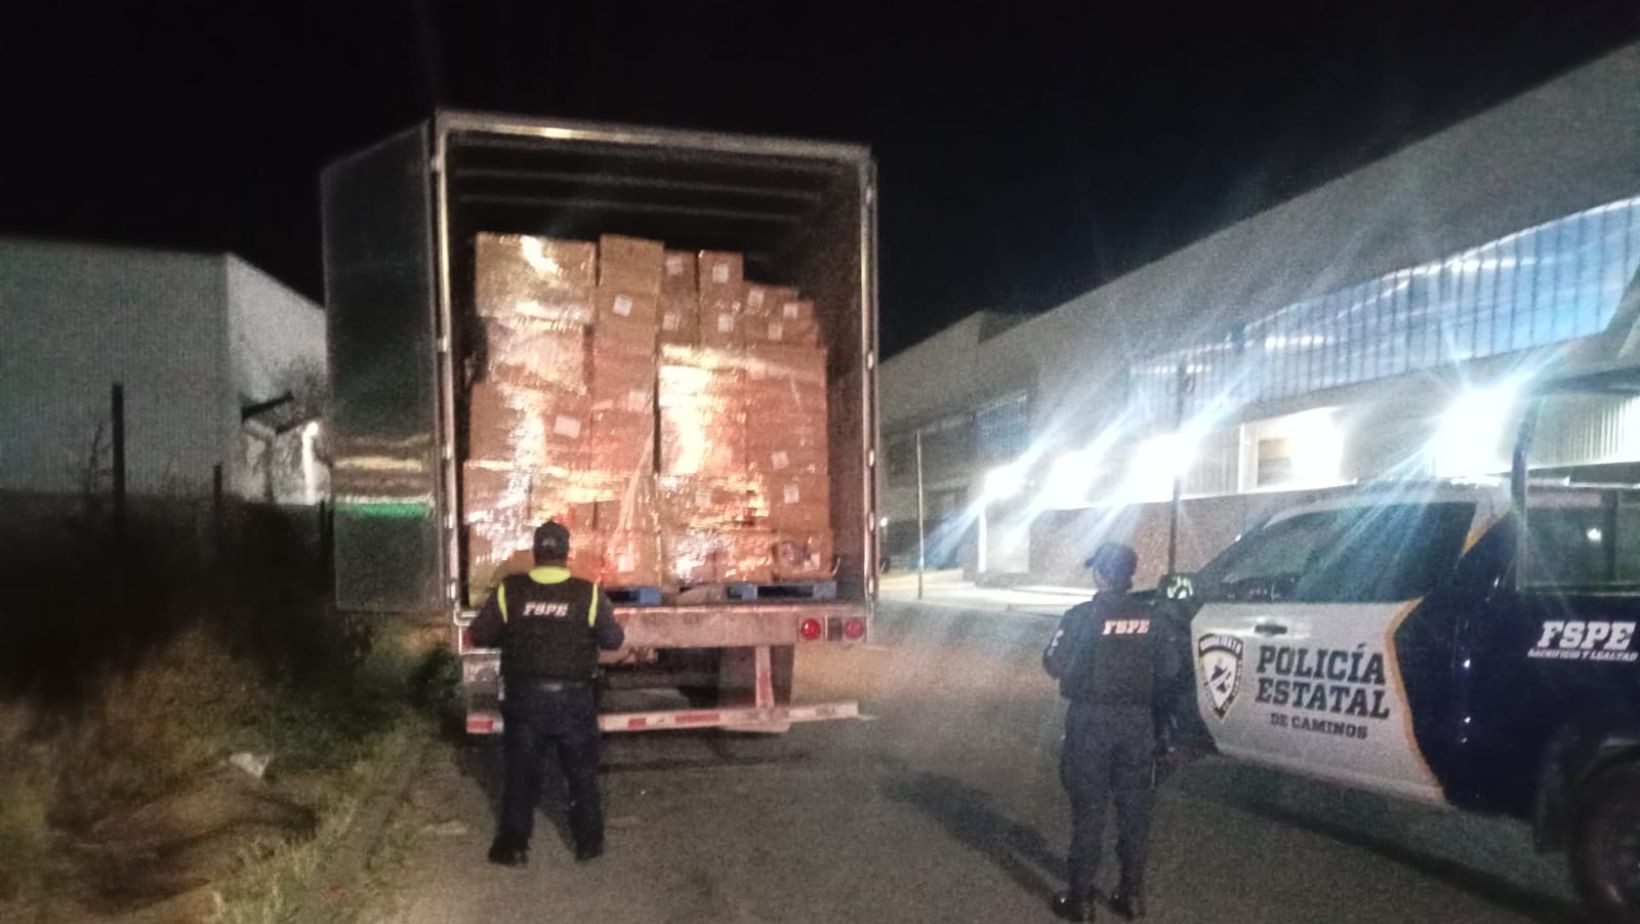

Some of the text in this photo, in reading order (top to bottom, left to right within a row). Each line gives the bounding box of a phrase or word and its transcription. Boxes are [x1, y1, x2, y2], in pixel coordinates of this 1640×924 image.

[522, 602, 568, 617] FSPE
[1102, 619, 1150, 635] FSPE
[1537, 621, 1636, 650] FSPE
[1256, 643, 1386, 685] POLICÍA
[1255, 677, 1390, 720] ESTATAL
[1270, 712, 1368, 740] DE CAMINOS
